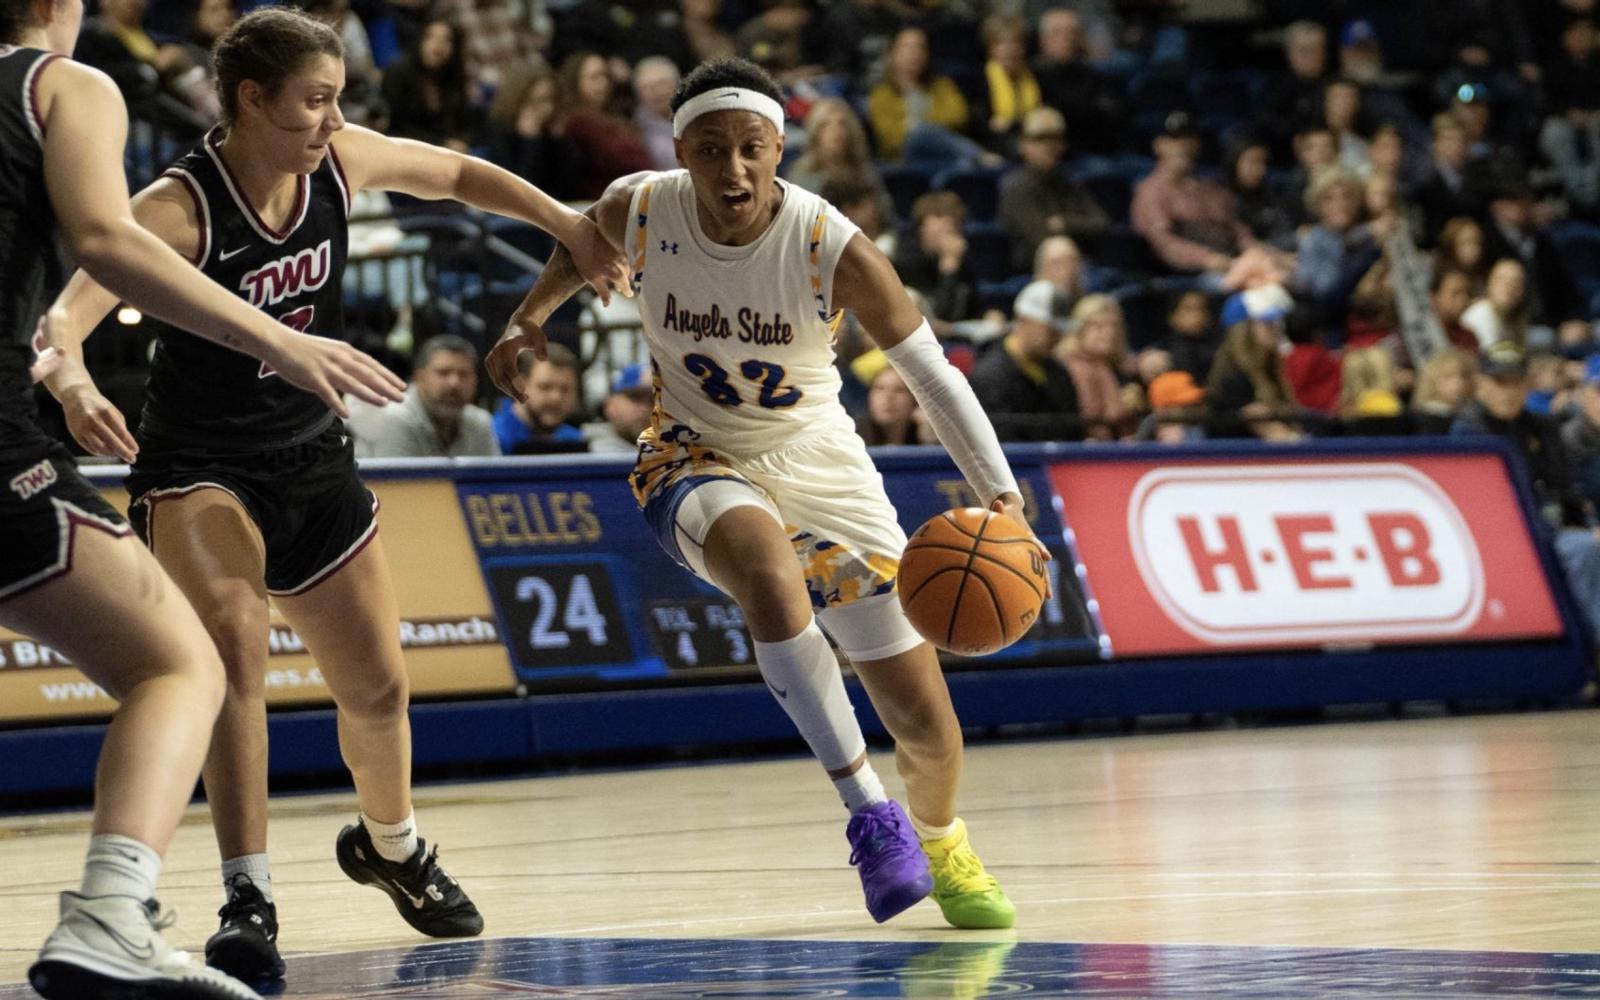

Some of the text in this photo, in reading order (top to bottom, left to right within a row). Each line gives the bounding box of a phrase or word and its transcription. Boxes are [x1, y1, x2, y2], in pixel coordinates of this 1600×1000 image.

[239, 239, 331, 309] TWU
[663, 292, 794, 346] Angelo State
[684, 353, 803, 409] 32
[10, 459, 57, 500] TWU
[466, 492, 601, 546] BELLES
[399, 617, 498, 645] Ranch
[516, 573, 608, 648] 24
